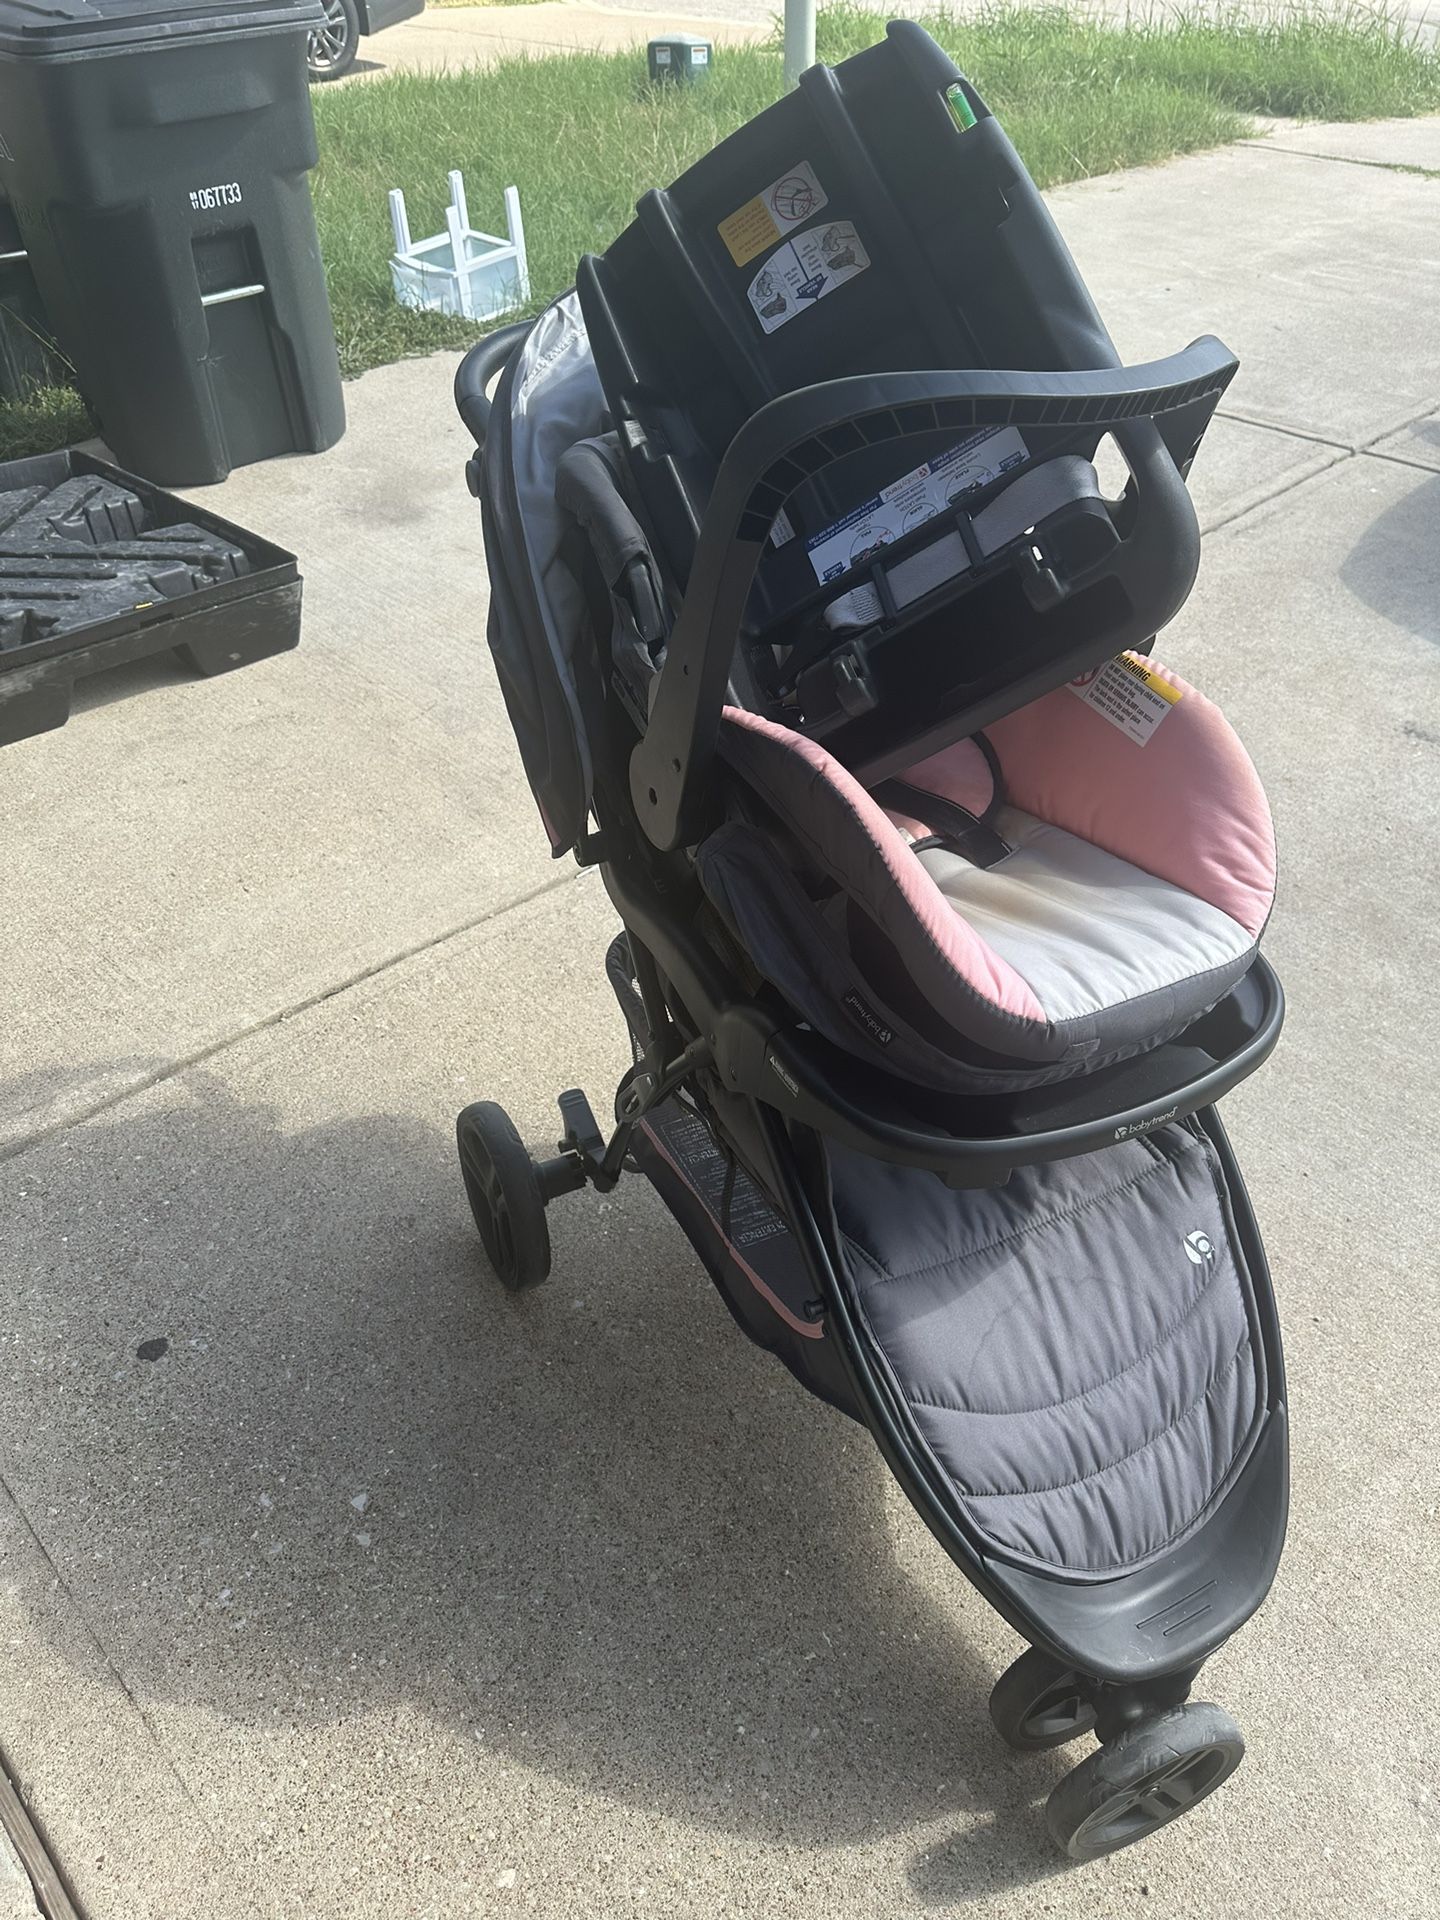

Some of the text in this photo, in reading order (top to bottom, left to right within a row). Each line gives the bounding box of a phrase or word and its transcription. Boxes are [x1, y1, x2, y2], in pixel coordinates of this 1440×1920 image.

[198, 182, 242, 210] 067733
[883, 472, 919, 499] babytrend
[847, 995, 881, 1035] babytrend
[1129, 1107, 1177, 1134] babytrend
